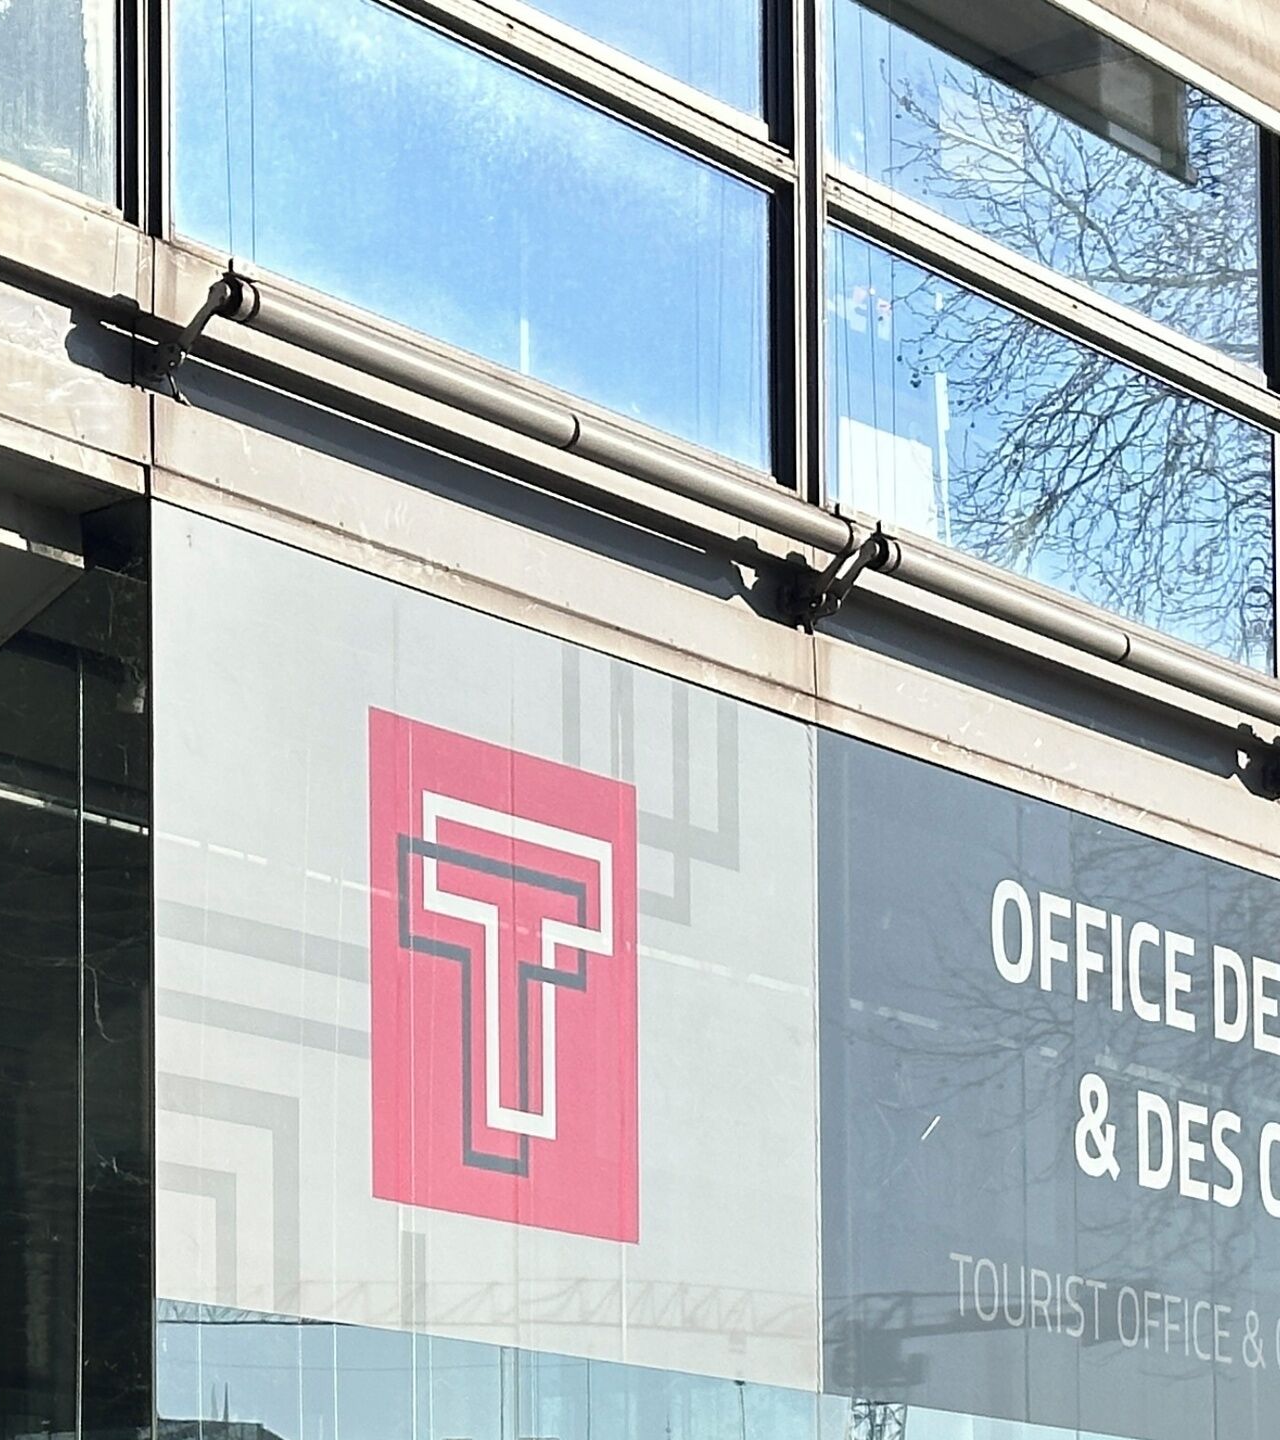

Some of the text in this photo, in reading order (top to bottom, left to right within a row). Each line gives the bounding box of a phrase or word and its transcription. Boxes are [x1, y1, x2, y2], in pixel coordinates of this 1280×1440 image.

[991, 879, 1196, 1033] OFFICE
[1075, 1073, 1121, 1181] &
[1137, 1091, 1243, 1208] DES
[949, 1252, 1107, 1339] TOURIST
[1117, 1286, 1233, 1364] OFFICE
[1242, 1310, 1266, 1369] &
